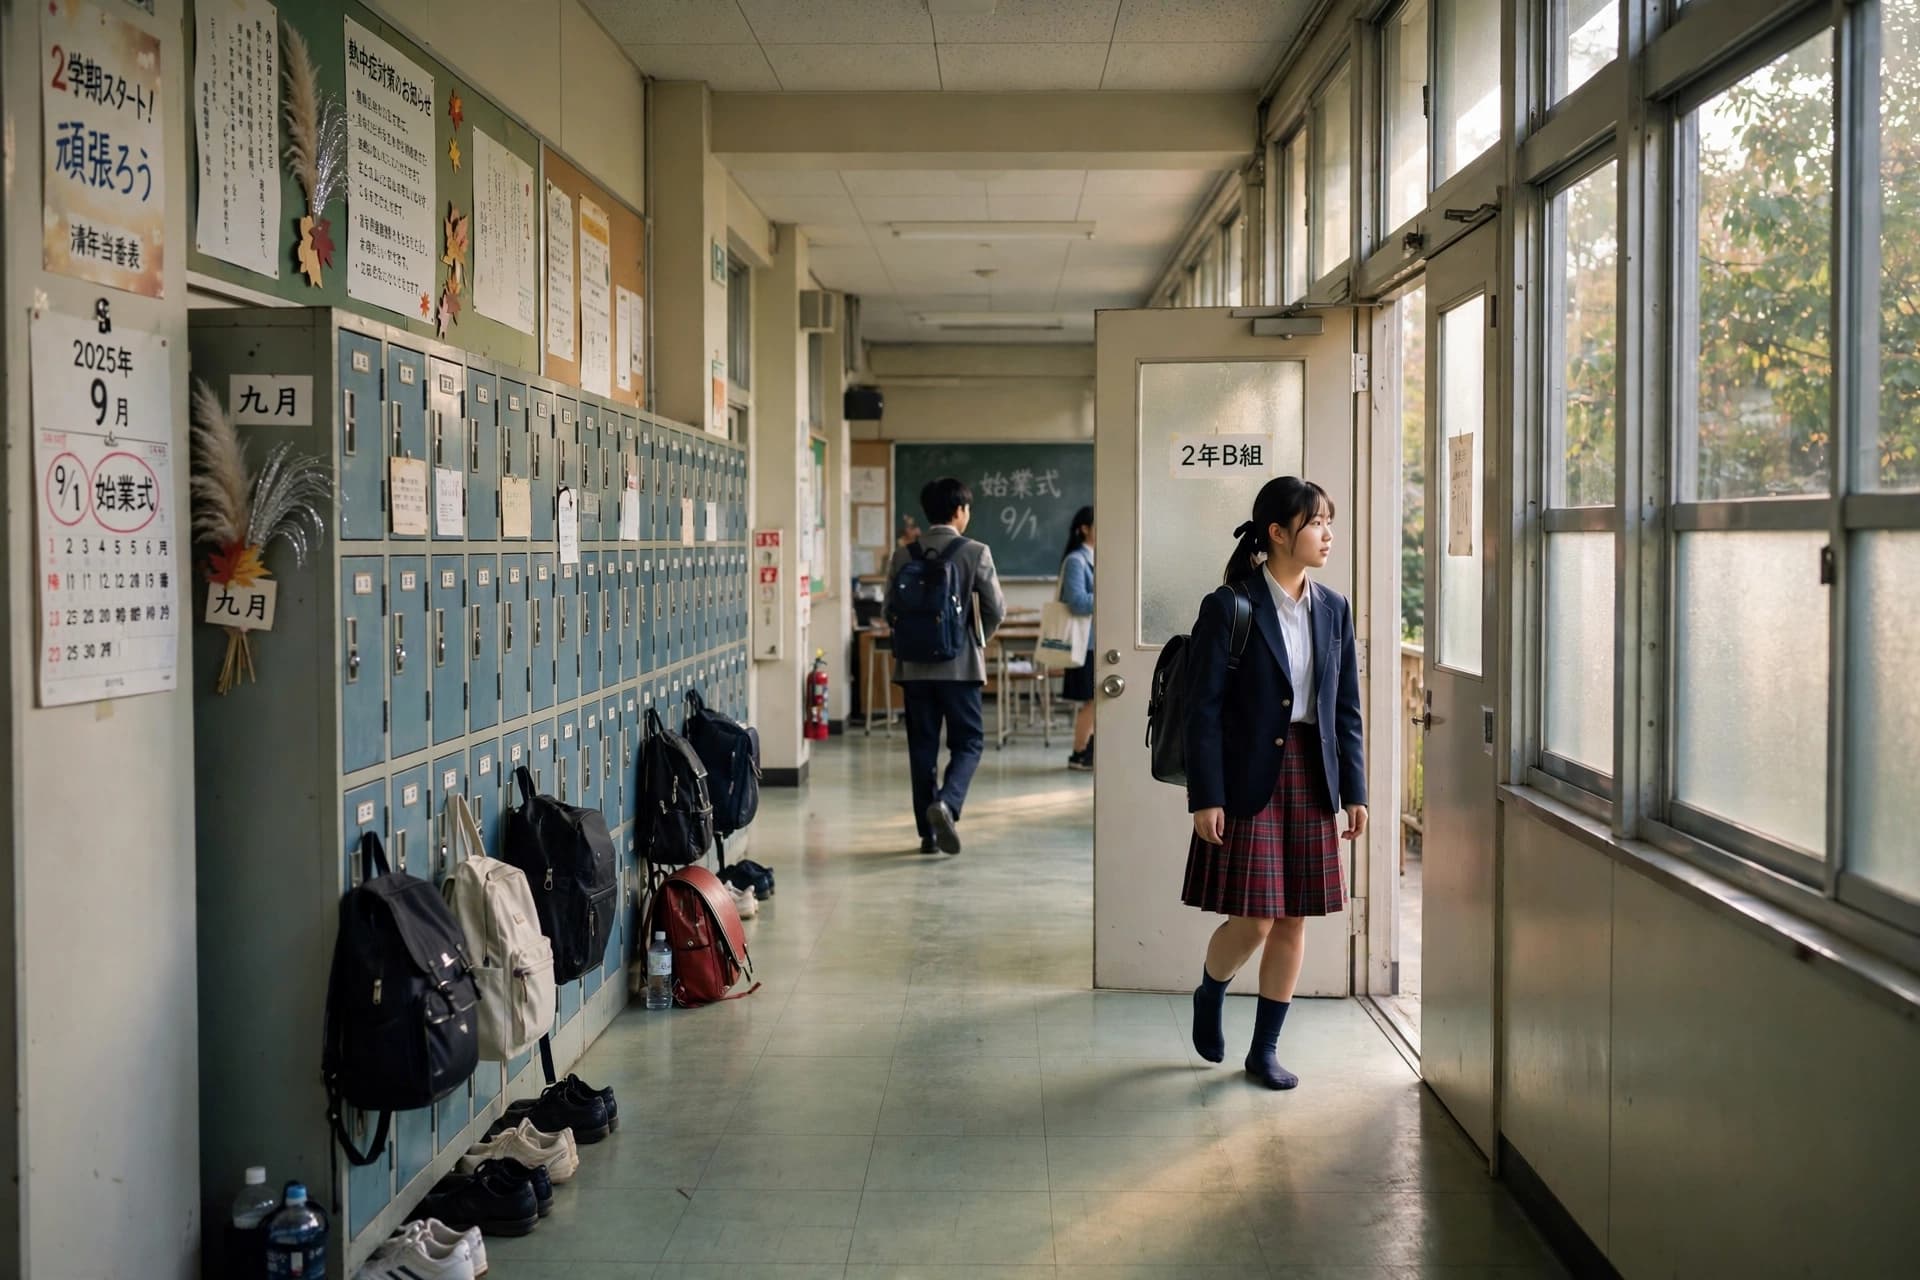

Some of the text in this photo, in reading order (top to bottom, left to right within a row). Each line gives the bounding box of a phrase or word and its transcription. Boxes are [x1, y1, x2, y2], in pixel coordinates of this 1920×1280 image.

[55, 121, 152, 202] 頑張ろう
[73, 339, 133, 379] 2025年
[239, 385, 296, 417] 九月
[1181, 443, 1264, 468] 2年B組
[95, 473, 155, 512] 始業式
[980, 467, 1062, 499] 始業式
[1001, 506, 1037, 540] 9/1
[66, 538, 73, 554] 2
[82, 538, 89, 554] 3
[114, 540, 121, 555] 5
[213, 587, 266, 621] 九月
